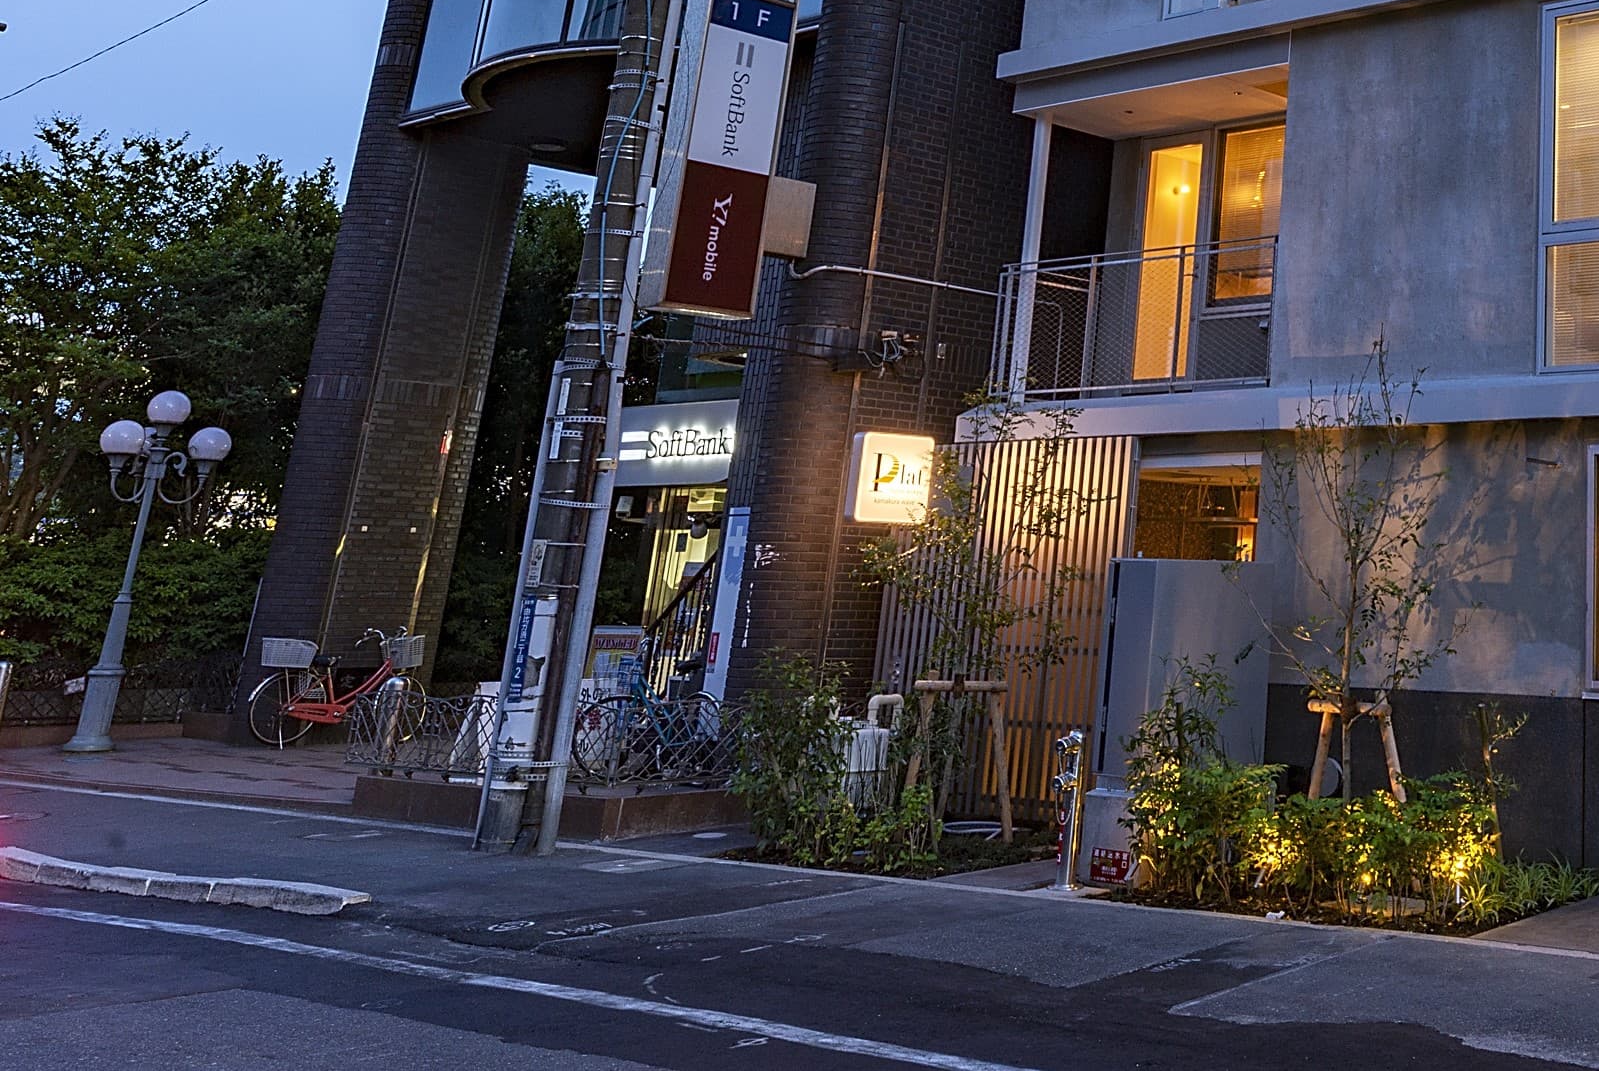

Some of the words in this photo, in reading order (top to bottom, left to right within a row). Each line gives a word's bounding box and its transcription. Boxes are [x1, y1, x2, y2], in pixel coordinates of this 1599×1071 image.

[721, 70, 750, 157] SoftBank
[646, 428, 733, 458] SoftBank
[514, 666, 521, 679] 2
